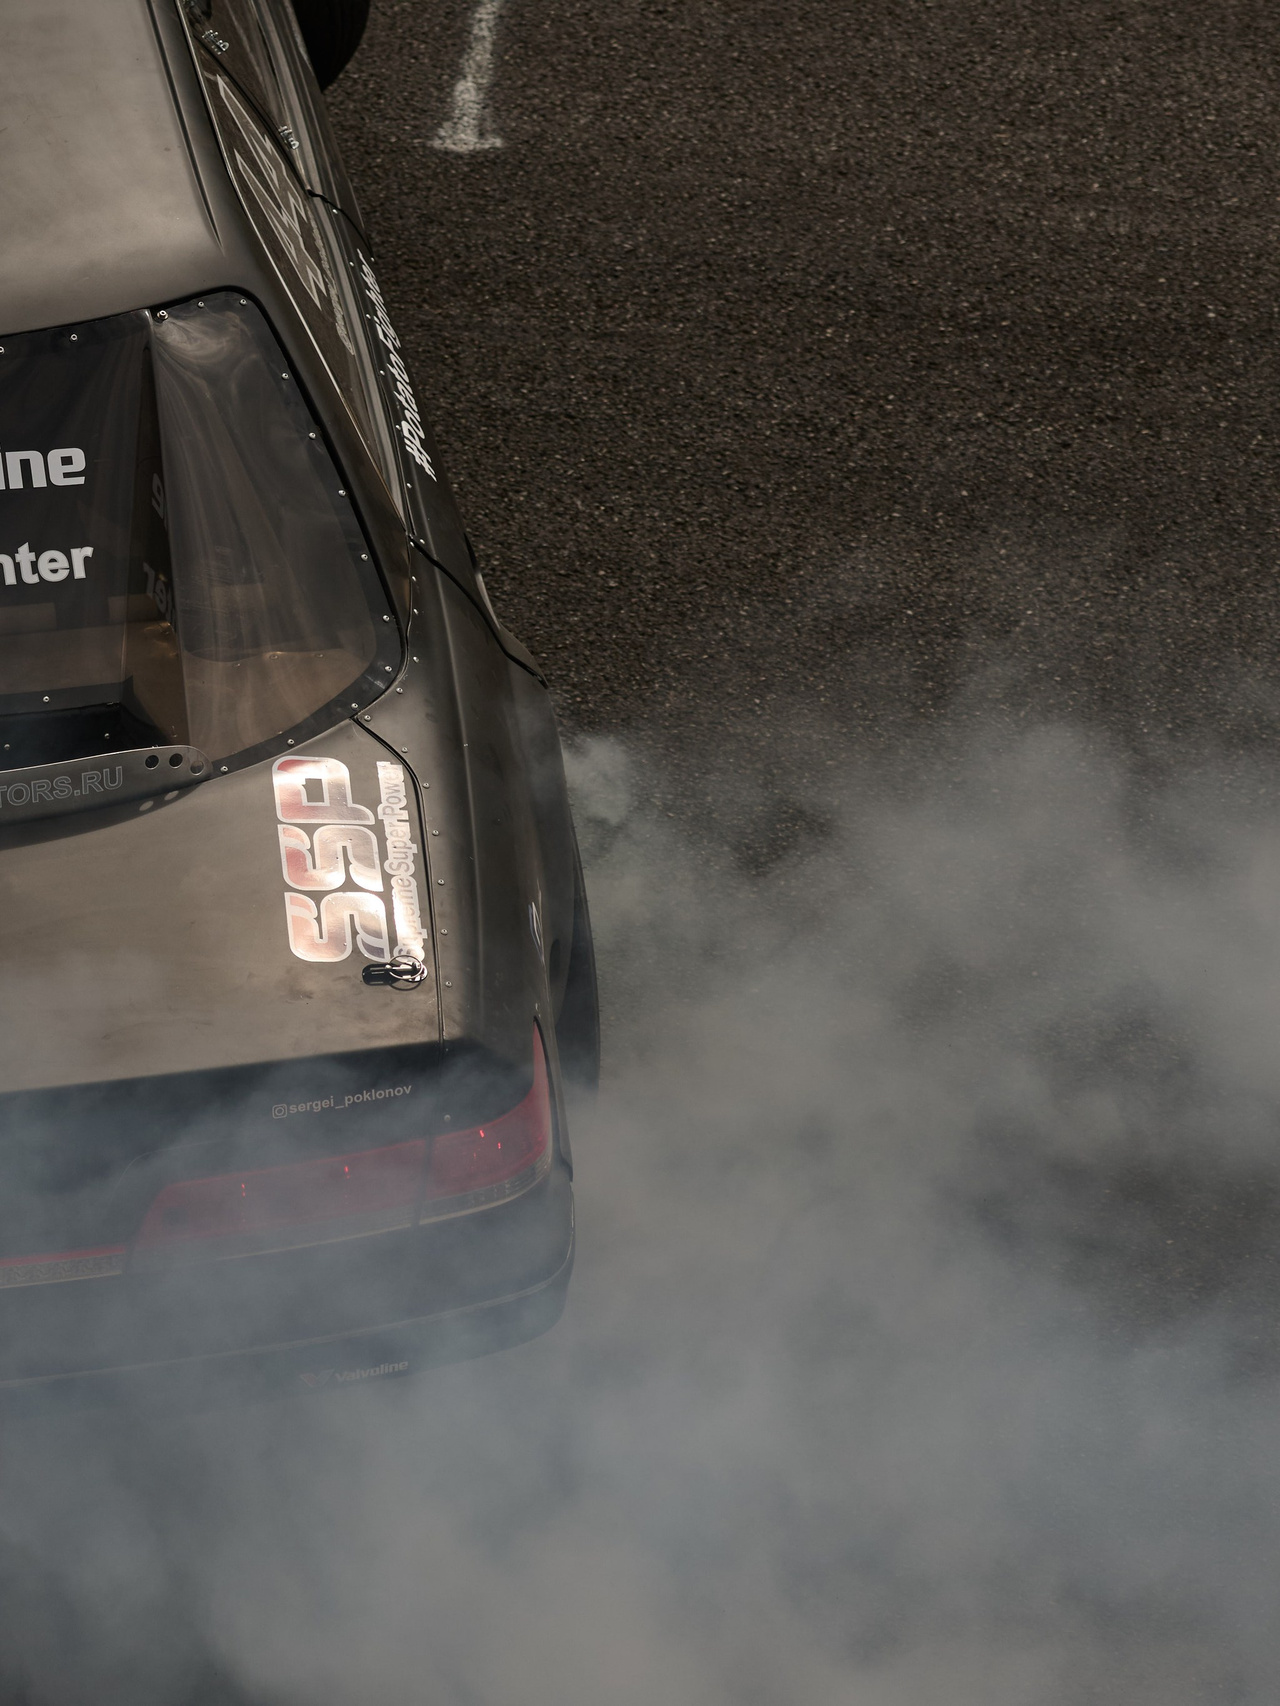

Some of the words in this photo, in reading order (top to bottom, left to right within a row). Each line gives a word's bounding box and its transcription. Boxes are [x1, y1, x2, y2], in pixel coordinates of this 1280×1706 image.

[381, 763, 405, 817] Power
[272, 755, 391, 963] SSP
[387, 820, 414, 873] Super
[334, 1361, 409, 1382] Valvoline
